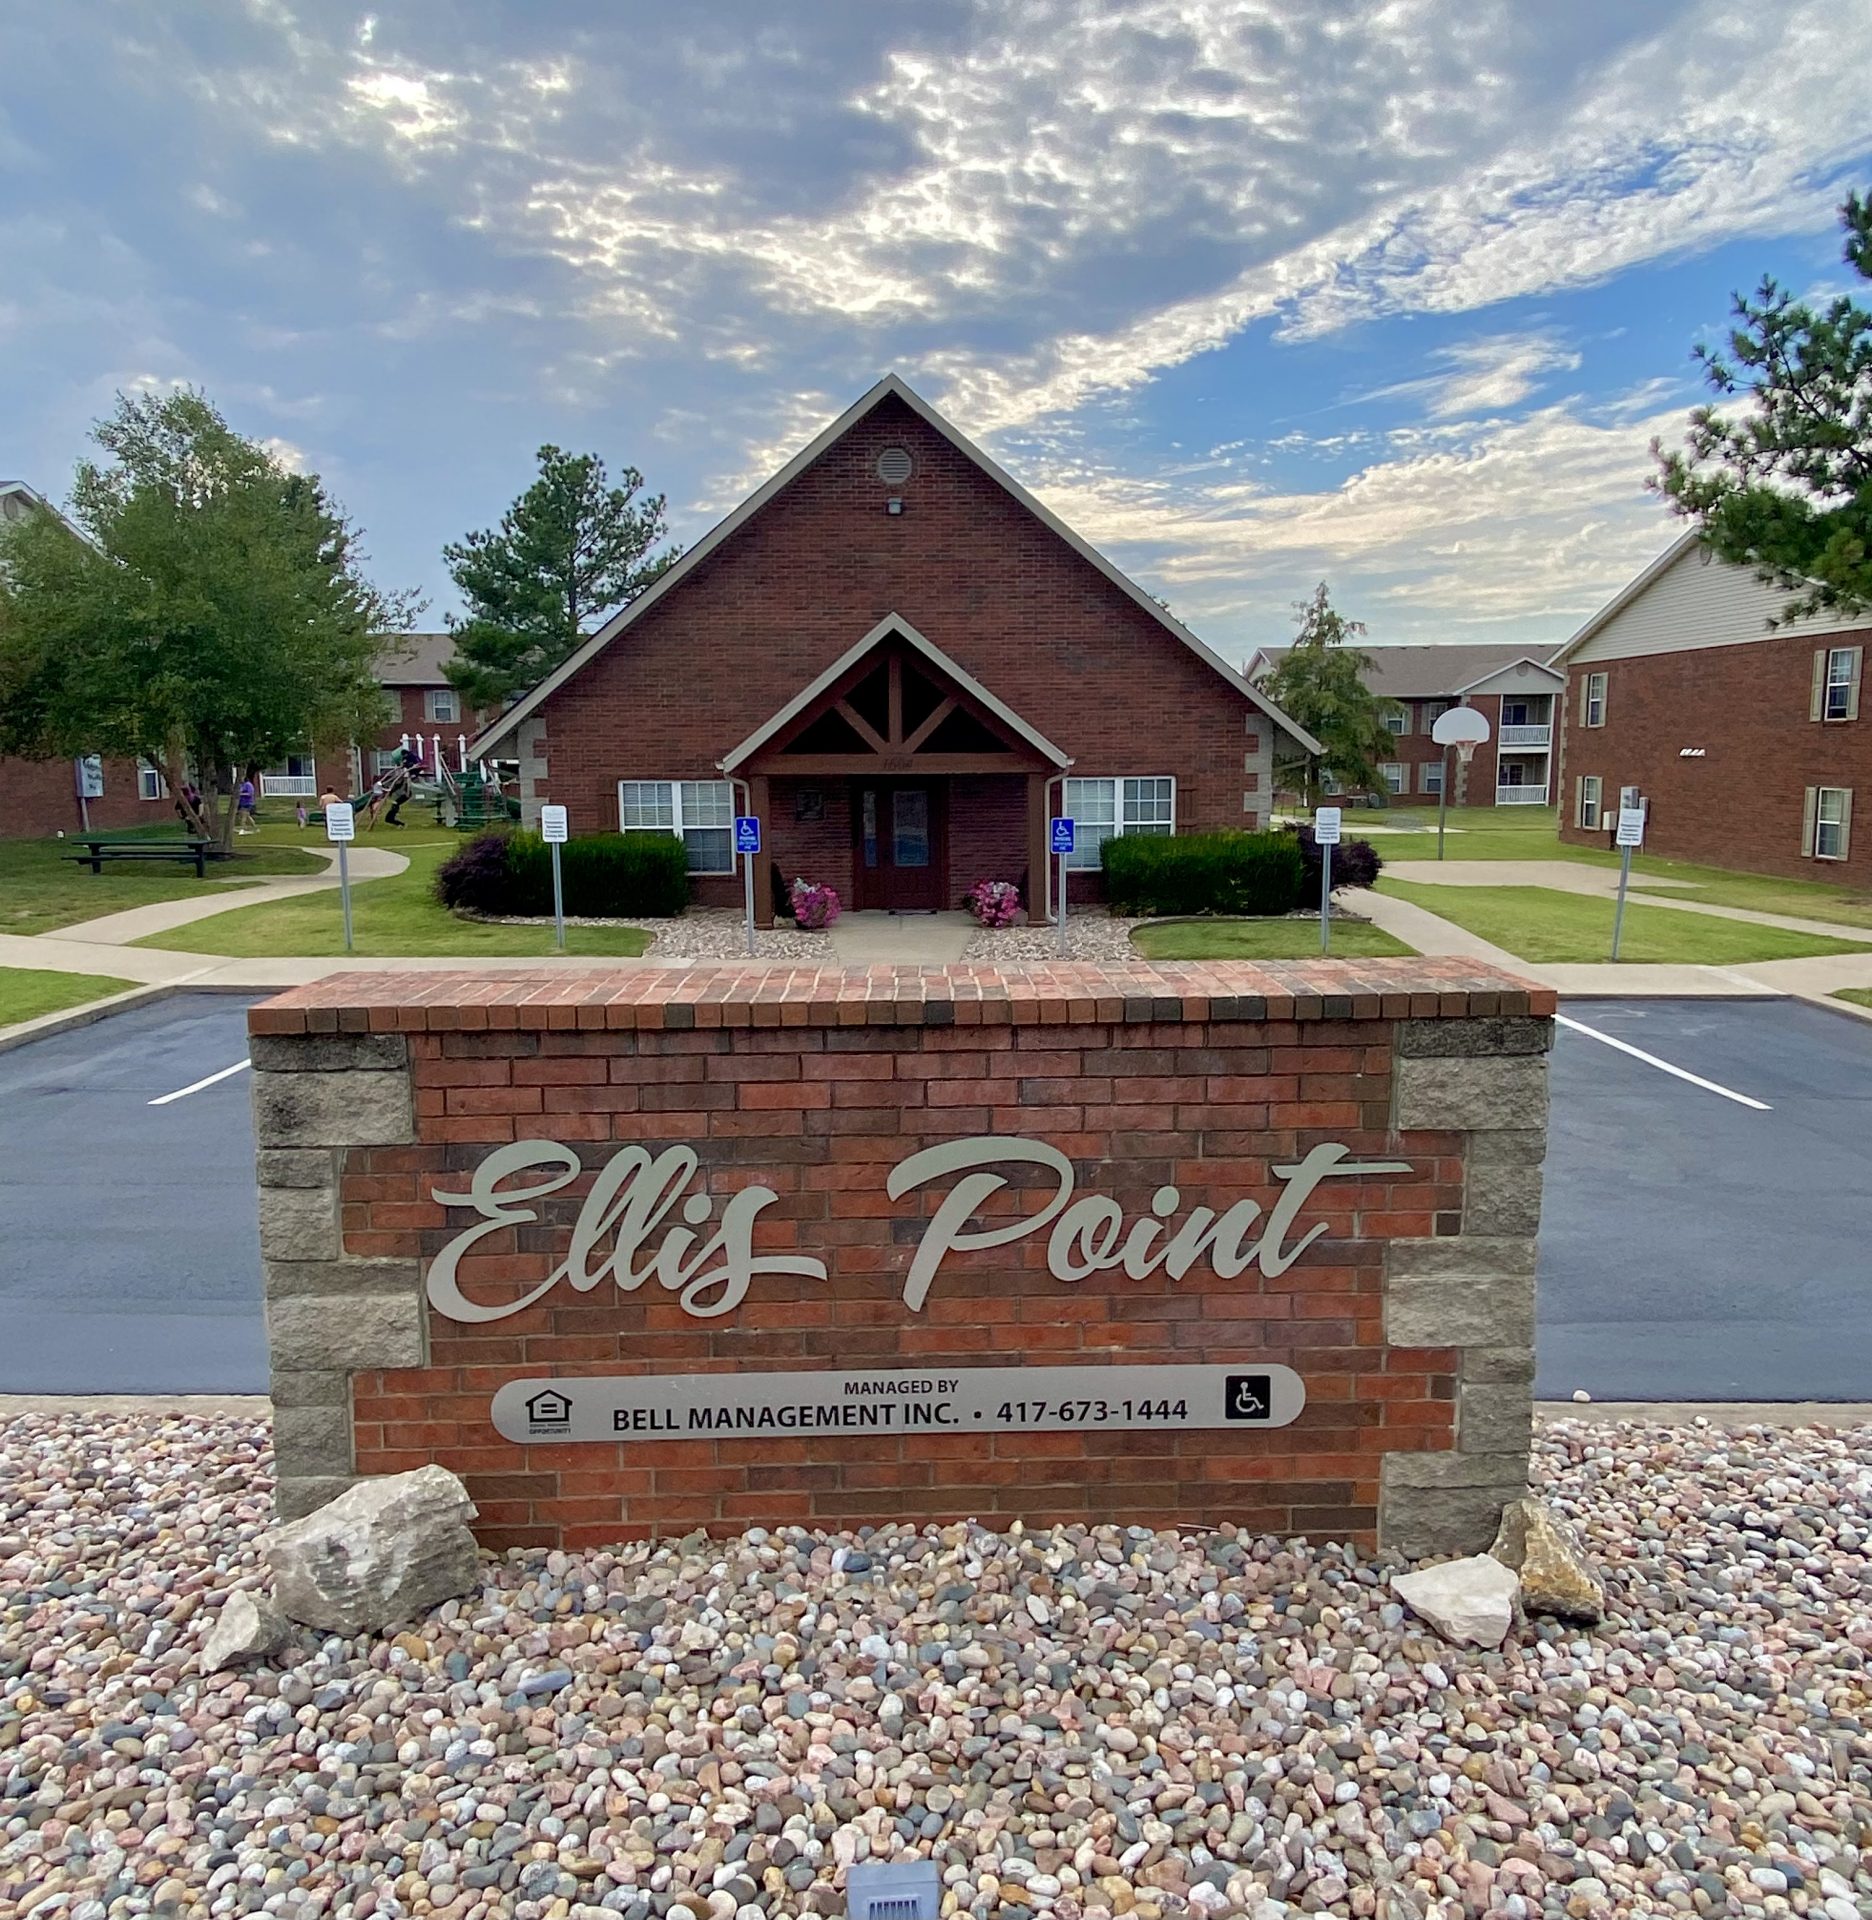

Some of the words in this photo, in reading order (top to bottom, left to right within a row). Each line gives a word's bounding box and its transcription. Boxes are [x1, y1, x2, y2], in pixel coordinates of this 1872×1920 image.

[427, 1139, 828, 1323] Ellis
[886, 1136, 1414, 1313] Point
[844, 1381, 933, 1395] MANAGED
[937, 1380, 959, 1394] BY
[613, 1408, 681, 1431] BELL
[688, 1402, 897, 1430] MANAGEMENT
[903, 1402, 960, 1426] INC.
[996, 1399, 1189, 1423] 417-673-1444
